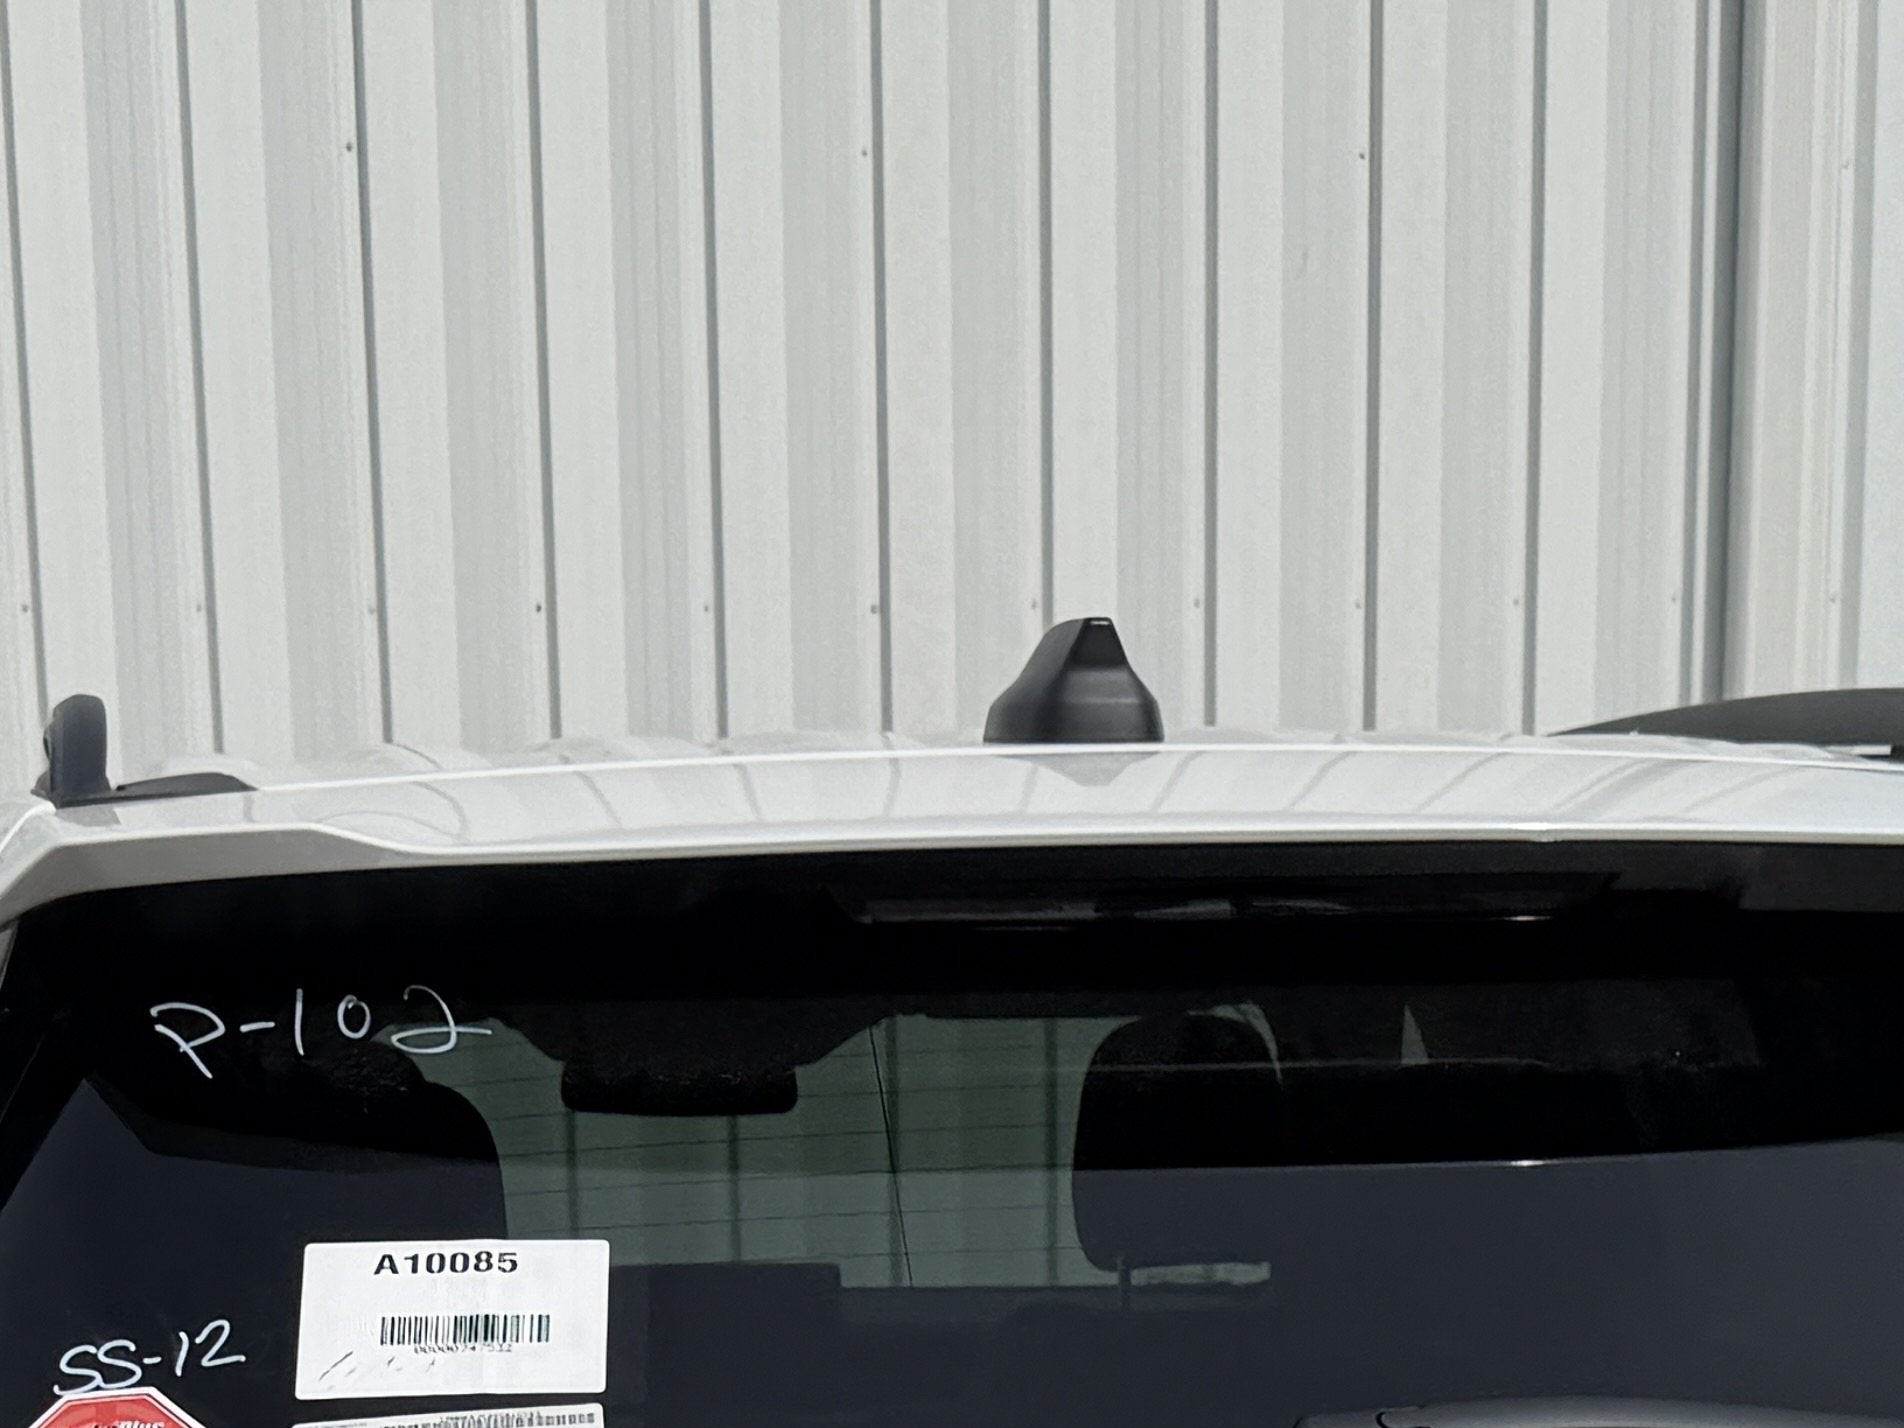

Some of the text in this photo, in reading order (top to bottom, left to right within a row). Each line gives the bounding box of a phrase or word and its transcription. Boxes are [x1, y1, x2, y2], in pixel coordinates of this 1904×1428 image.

[150, 985, 492, 1078] P-102
[373, 1251, 518, 1275] A10085
[52, 1319, 246, 1395] SS-12
